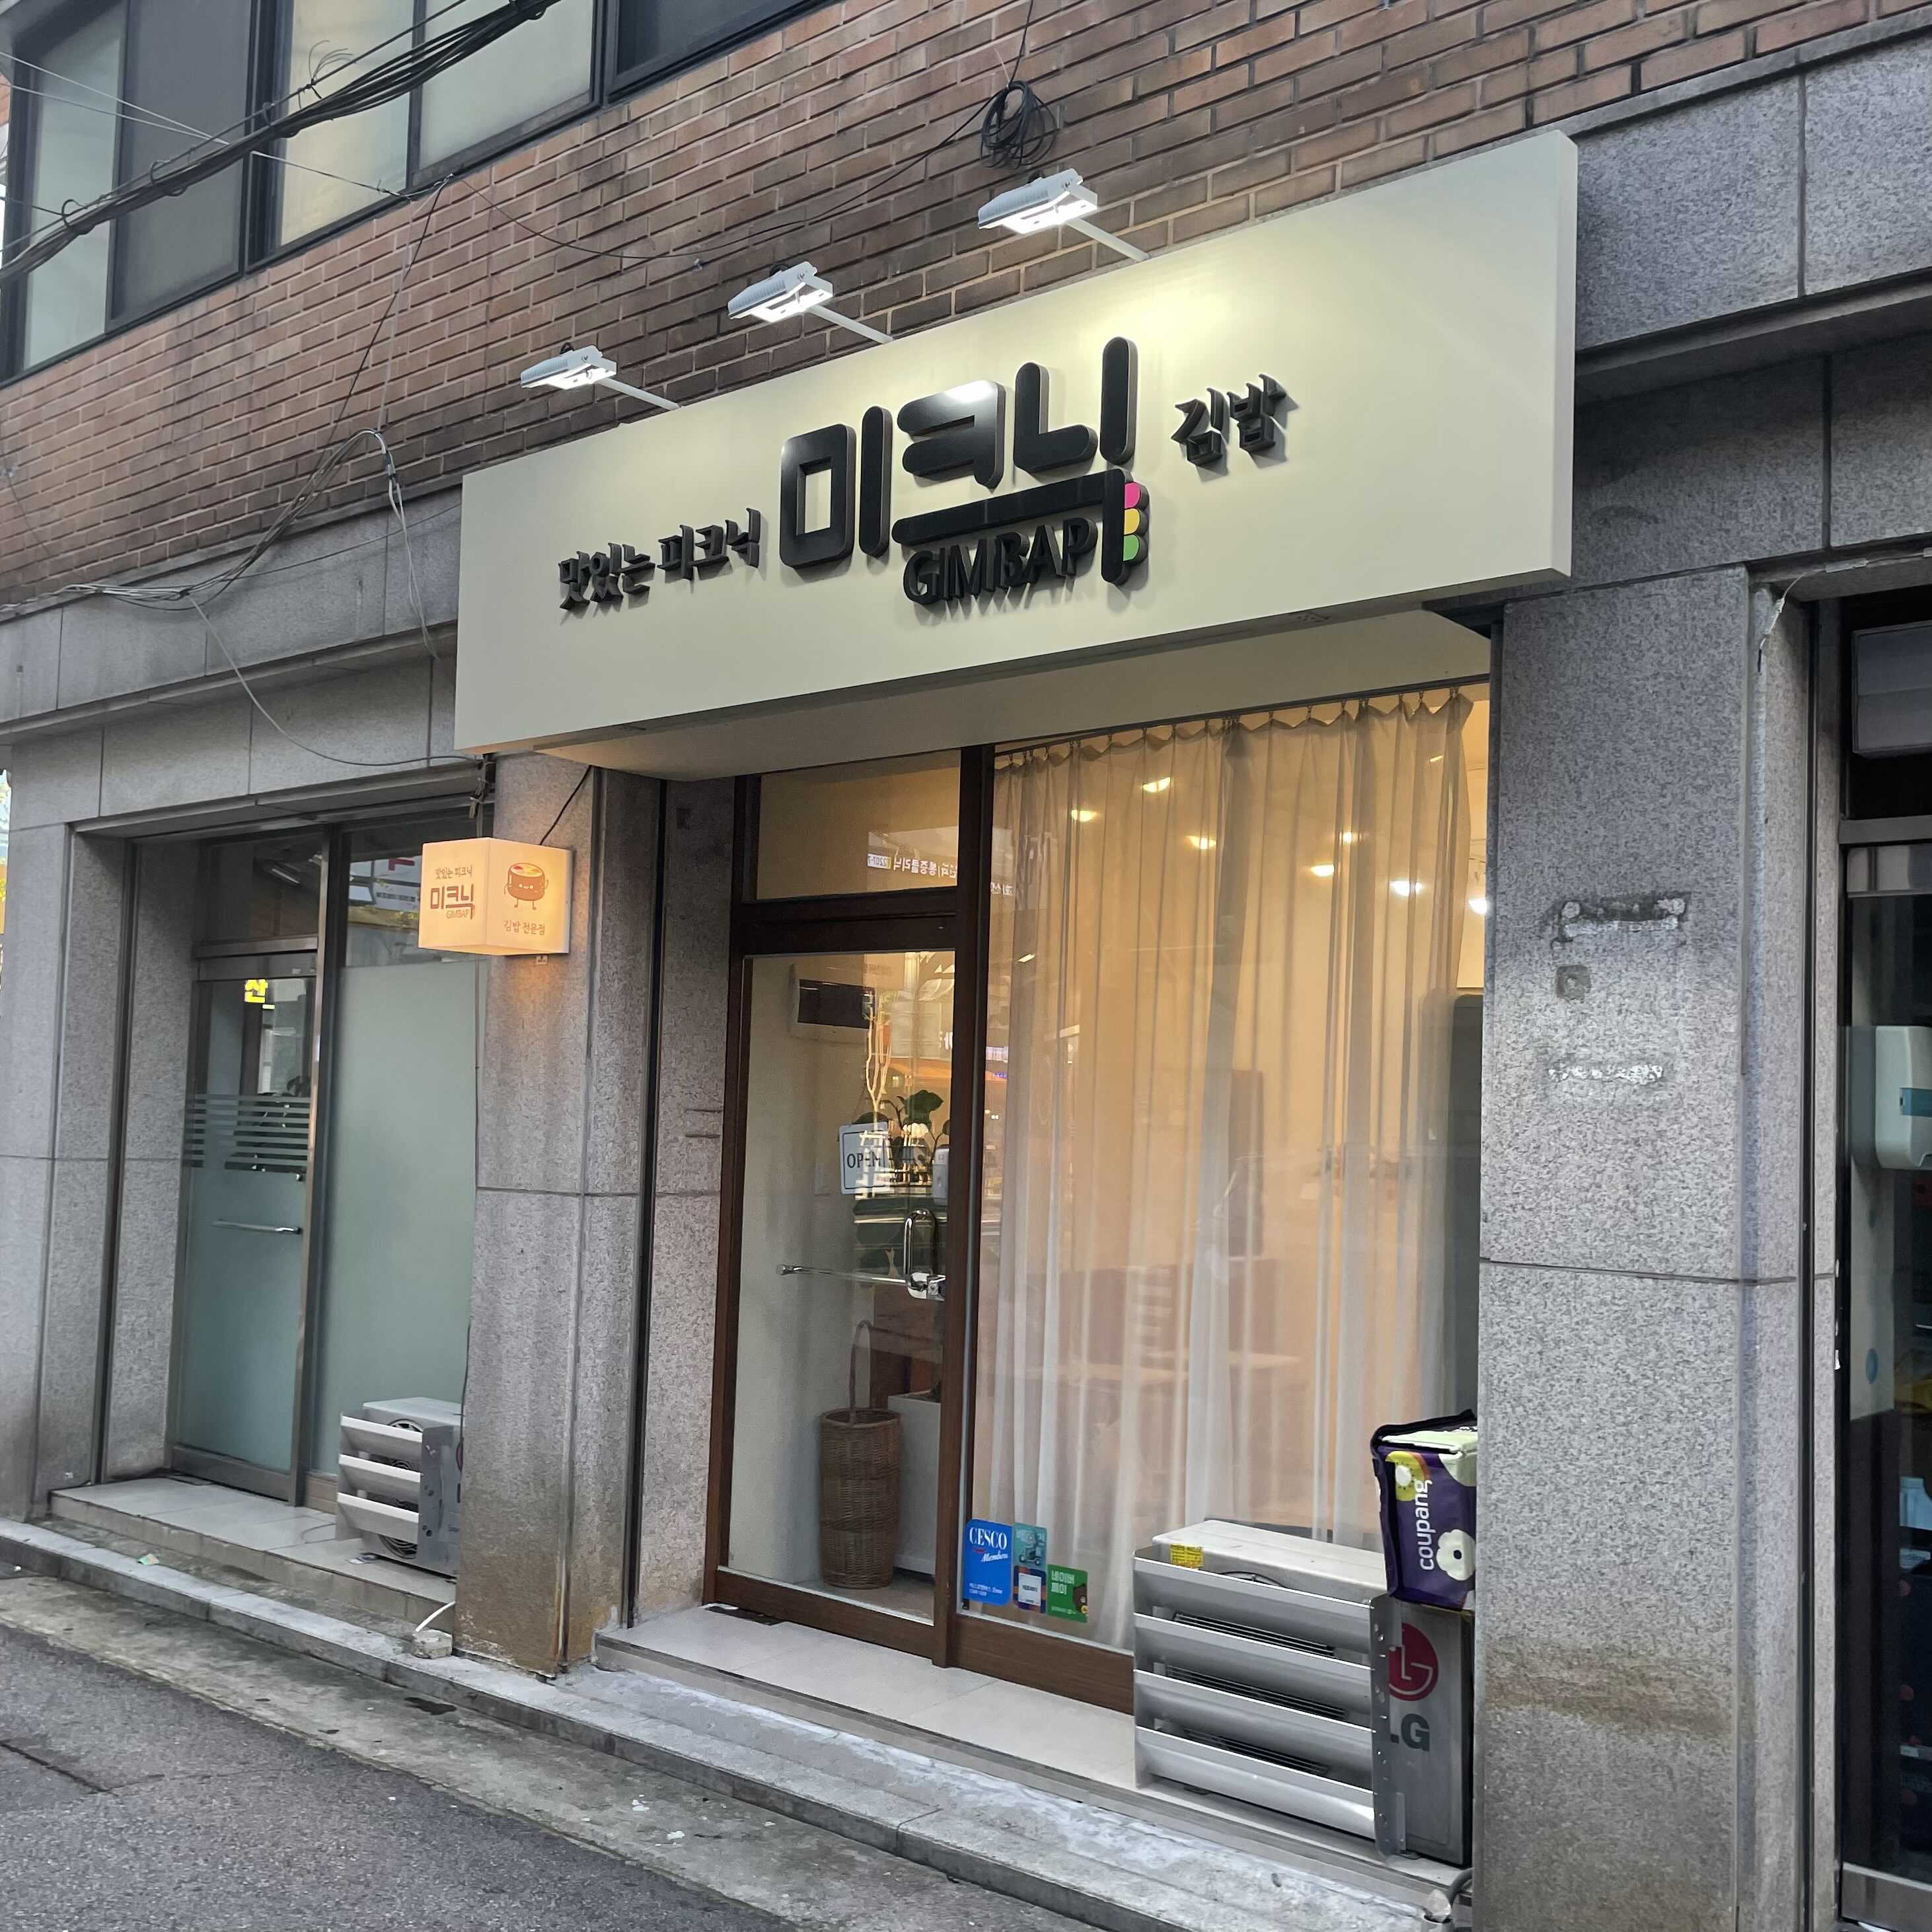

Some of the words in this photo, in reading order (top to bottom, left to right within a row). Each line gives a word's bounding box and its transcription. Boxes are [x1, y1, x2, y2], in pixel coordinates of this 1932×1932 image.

[1171, 372, 1287, 468] 김밥
[559, 541, 655, 611] 맛있는
[657, 506, 762, 581] 피크닉
[903, 515, 1098, 608] GIMBAP
[435, 866, 454, 879] 맛있는
[455, 864, 473, 877] 피크닉
[446, 909, 470, 919] GIMBAP
[504, 919, 521, 933] 김밥
[523, 922, 545, 936] 전문점
[969, 1527, 1008, 1550] CESCO
[1415, 1479, 1434, 1571] coupang
[1390, 1713, 1430, 1752] G
